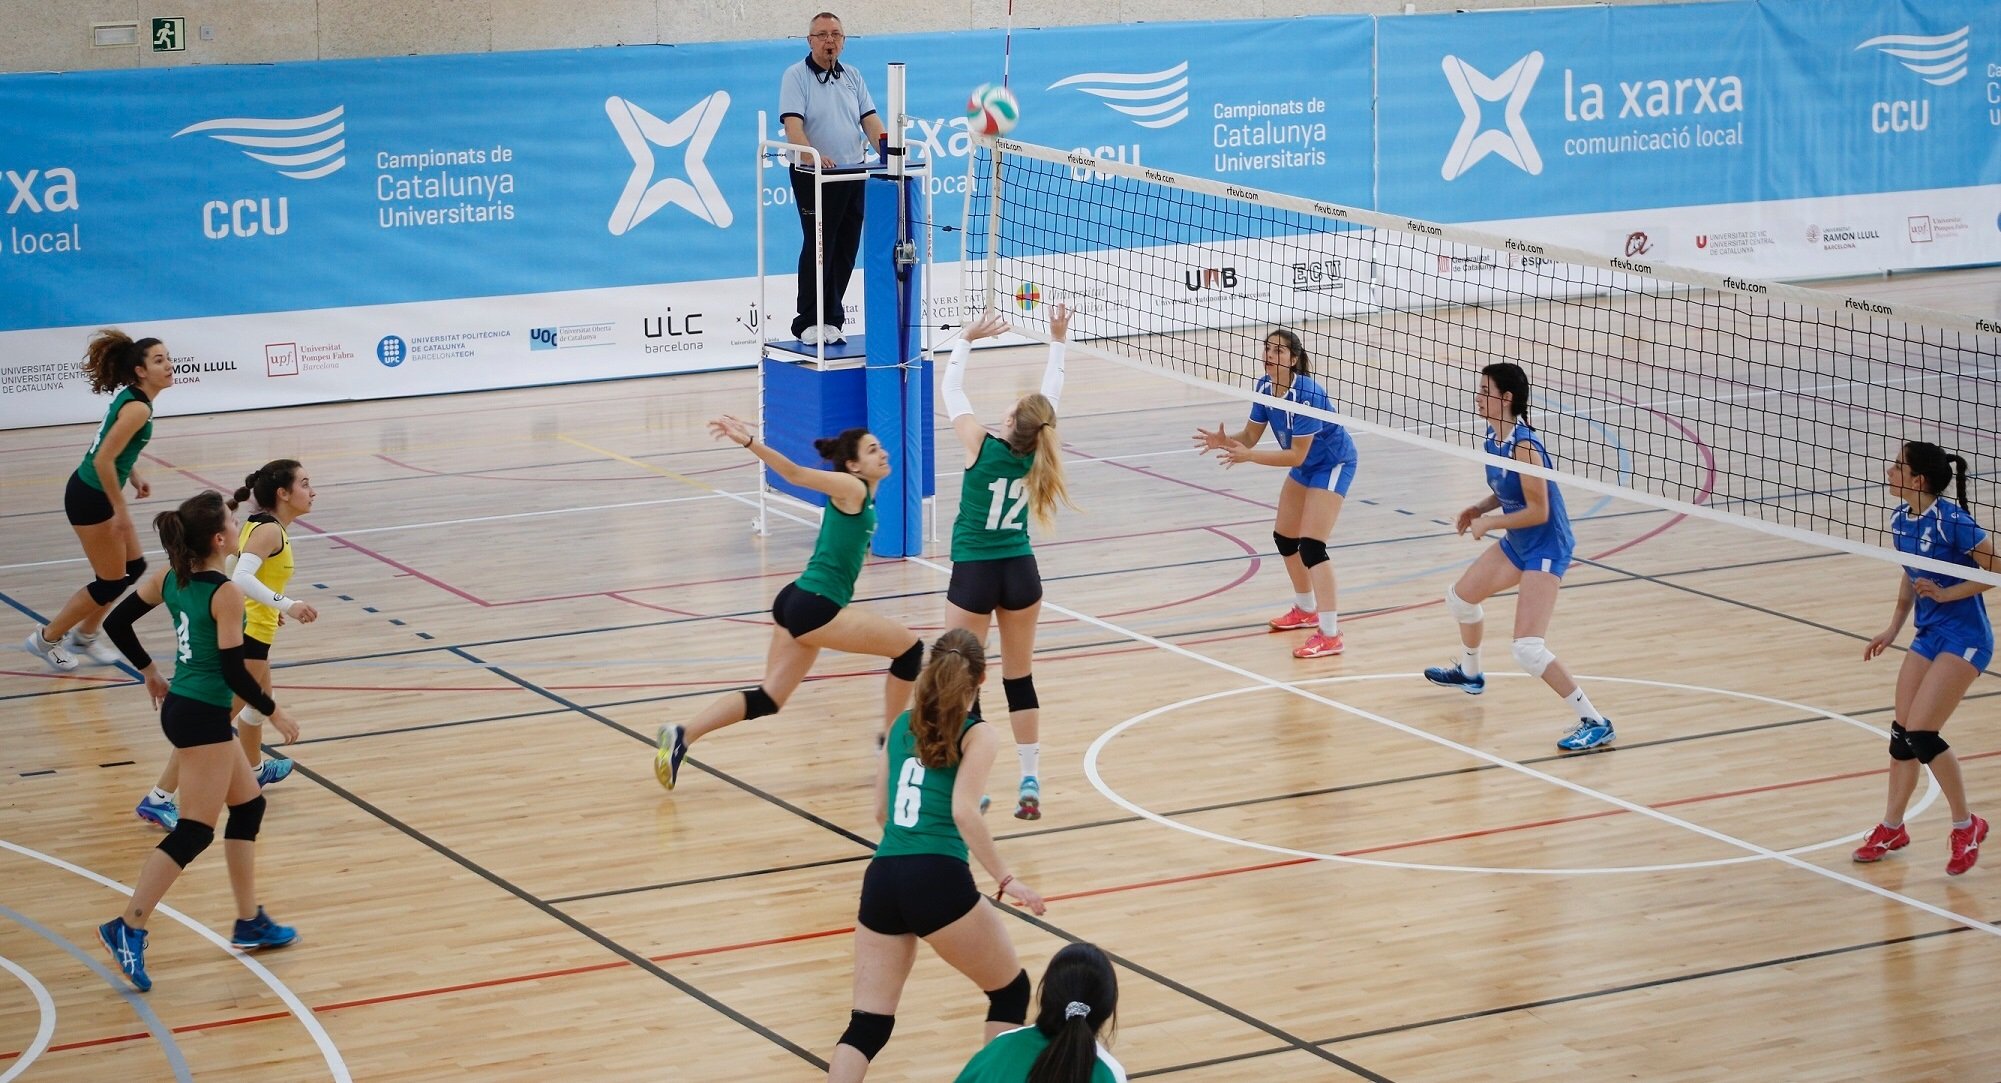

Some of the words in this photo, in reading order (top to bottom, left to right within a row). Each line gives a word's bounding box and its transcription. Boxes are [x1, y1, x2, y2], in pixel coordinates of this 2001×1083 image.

[1564, 68, 1605, 122] la
[1618, 75, 1744, 119] xarxa
[1213, 100, 1304, 121] Campionats
[1307, 96, 1326, 113] de
[1871, 99, 1929, 134] CCU
[1213, 119, 1327, 149] Catalunya
[1564, 125, 1691, 156] comunicació
[1696, 121, 1743, 147] local
[377, 148, 486, 172] Campionats
[491, 144, 513, 163] de
[1214, 147, 1327, 173] Universitaris
[377, 170, 515, 202] Catalunya
[1226, 186, 1260, 201] rfevb.com
[203, 196, 289, 240] CCU
[378, 199, 515, 229] Universitaris
[1313, 203, 1348, 218] rfevb.com
[1407, 220, 1443, 237] rfevb.com
[1709, 231, 1749, 241] UNIVERSITAT
[1823, 232, 1855, 242] RAMON
[1857, 230, 1880, 240] LLULL
[11, 223, 82, 255] local
[1505, 237, 1544, 256] rfevb.com
[1709, 239, 1749, 249] UNIVERSITAT
[1719, 247, 1755, 256] CATALUNYA
[1823, 243, 1857, 251] BARCELONA
[1293, 260, 1342, 285] ECU
[1609, 257, 1652, 275] rfevb.com
[1722, 277, 1768, 295] rfevb.com
[1844, 298, 1893, 316] rfevb.com
[559, 326, 591, 335] Universitat
[592, 325, 612, 333] Oberta
[411, 333, 460, 344] UNIVERSITAT
[567, 334, 597, 343] Catalunya
[300, 343, 342, 353] Universitat
[423, 343, 466, 352] CATALUNYA
[644, 340, 704, 354] barcelona
[301, 353, 331, 363] Pompeu
[332, 351, 355, 360] Fabra
[384, 356, 400, 364] UPC
[412, 350, 475, 362] BARCELONATECH
[1, 363, 56, 376] UNIVERSITAT
[57, 362, 69, 372] DE
[172, 363, 201, 374] MON
[204, 360, 238, 372] LLULL
[302, 362, 340, 371] Barcelona
[1, 373, 56, 385] UNIVERSITAT
[174, 376, 201, 385] ELONA
[2, 385, 15, 394] DE
[16, 381, 65, 393] CATALUNYA
[985, 477, 1029, 530] 12
[893, 756, 926, 829] 6
